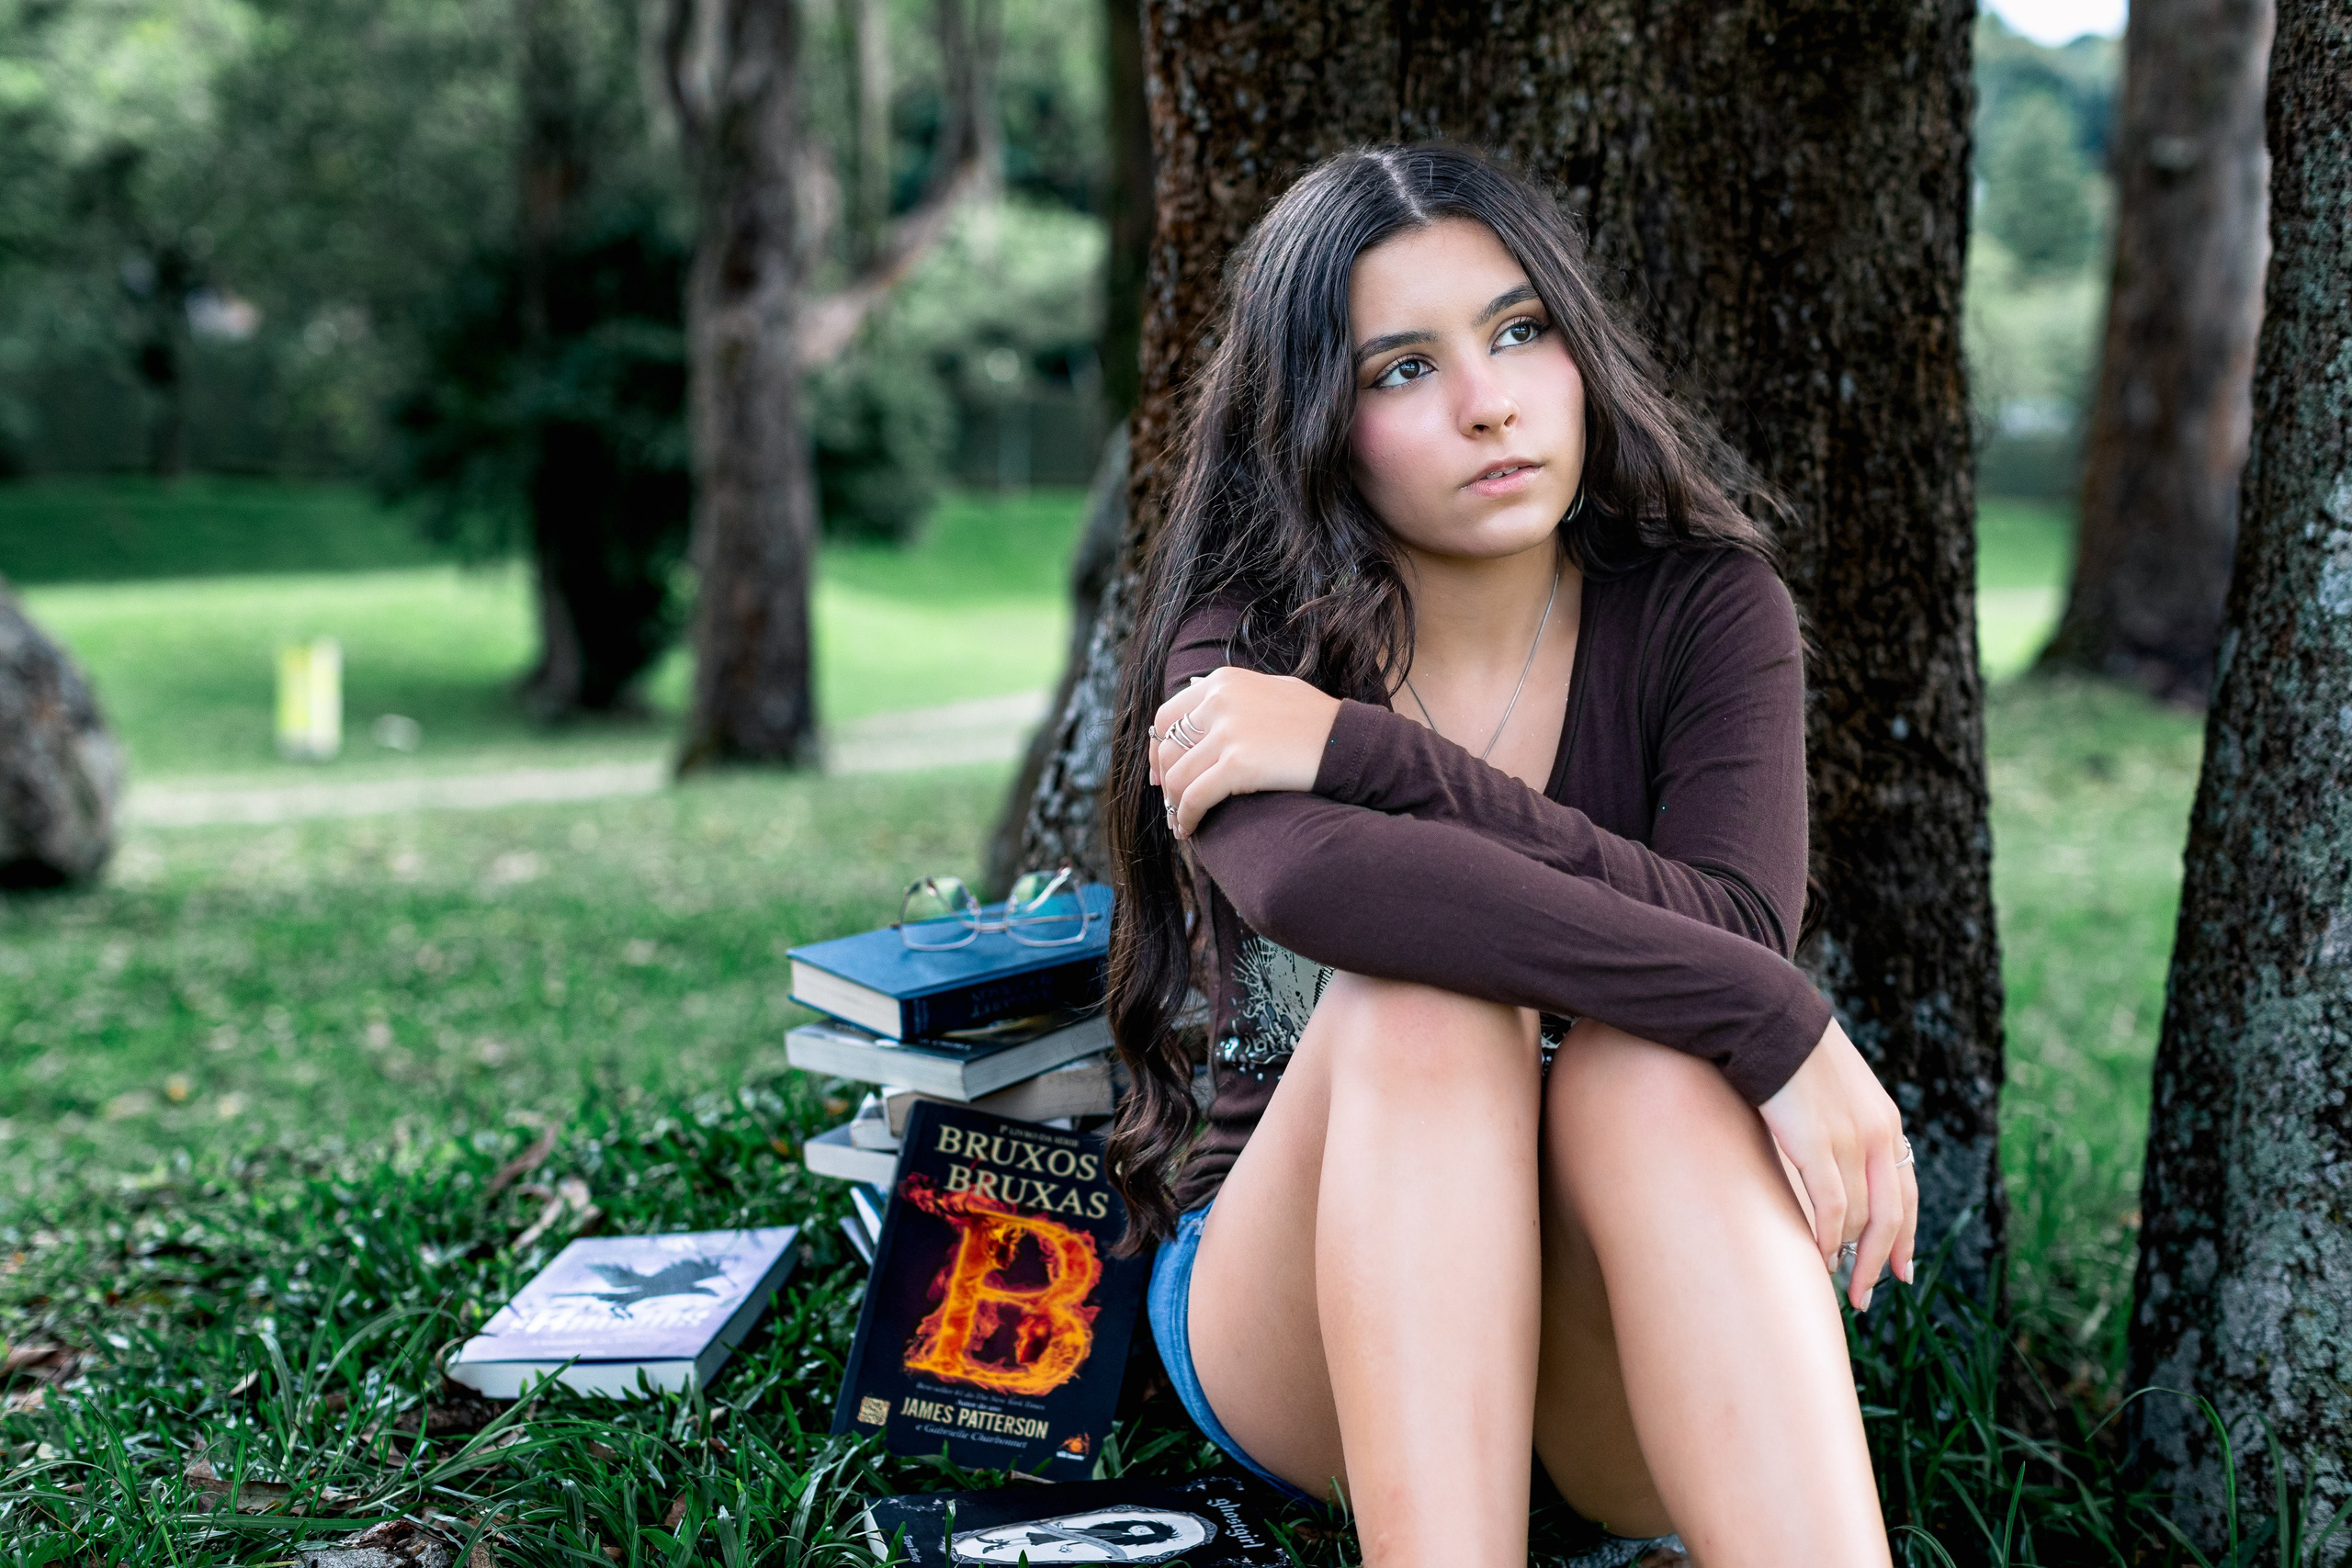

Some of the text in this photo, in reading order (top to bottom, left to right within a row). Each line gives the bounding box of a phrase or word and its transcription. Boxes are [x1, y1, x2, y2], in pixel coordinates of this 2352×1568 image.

[933, 1123, 1099, 1182] BRUXOS
[943, 1163, 1110, 1219] BRUXAS
[900, 1396, 955, 1425] JAMES
[956, 1407, 1050, 1440] PATTERSON
[914, 1423, 1029, 1450] e Gabrielle Charbonnet
[1205, 1497, 1266, 1550] ghostgirl
